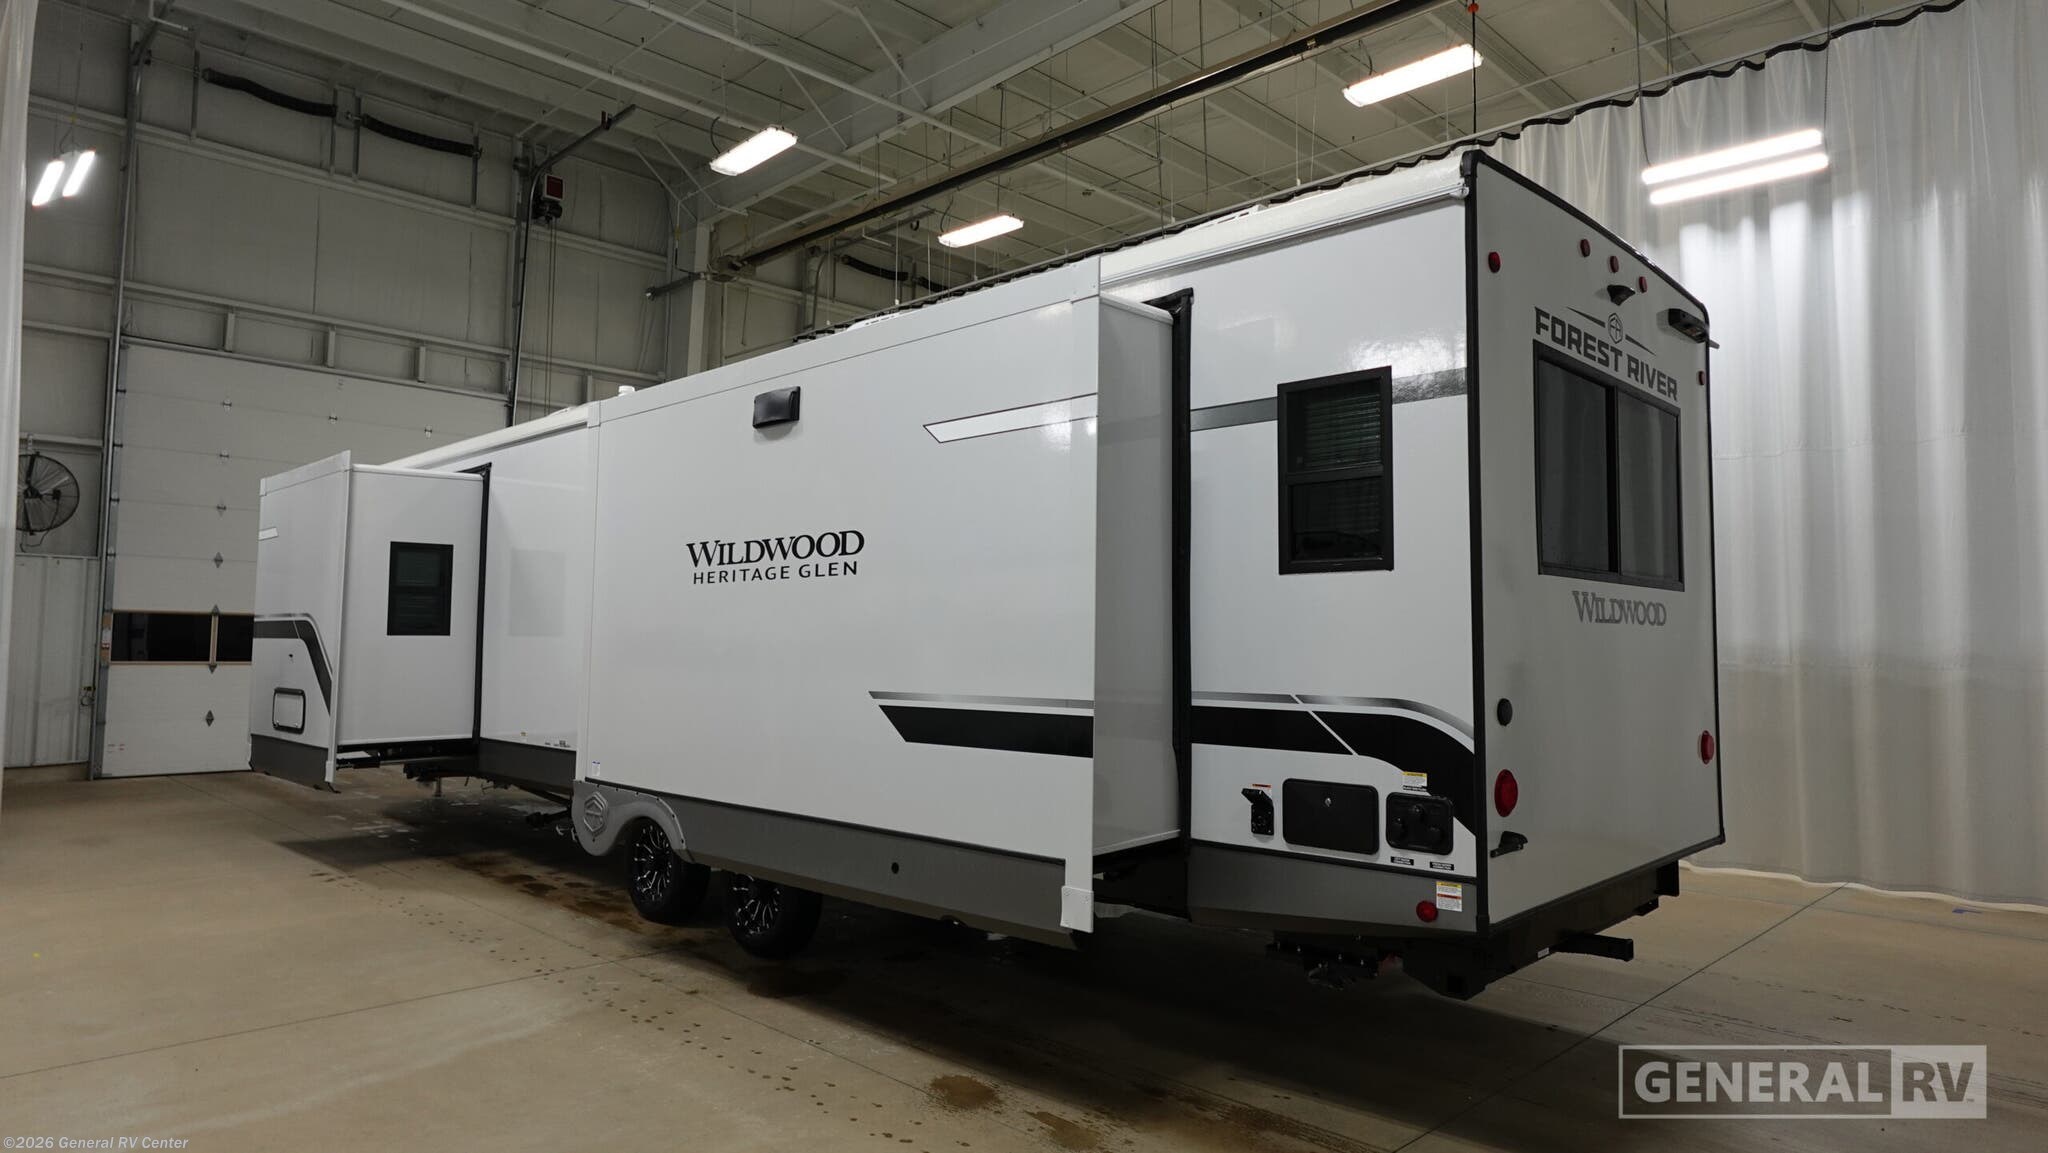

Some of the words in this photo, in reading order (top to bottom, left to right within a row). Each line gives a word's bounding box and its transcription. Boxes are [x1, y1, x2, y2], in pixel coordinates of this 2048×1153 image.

[1534, 306, 1623, 373] FOREST
[1626, 353, 1678, 402] RIVER
[686, 529, 865, 568] WILDWOOD
[693, 565, 791, 585] HERITAGE
[798, 560, 858, 579] GLEN
[1571, 590, 1668, 627] WILDWOOD
